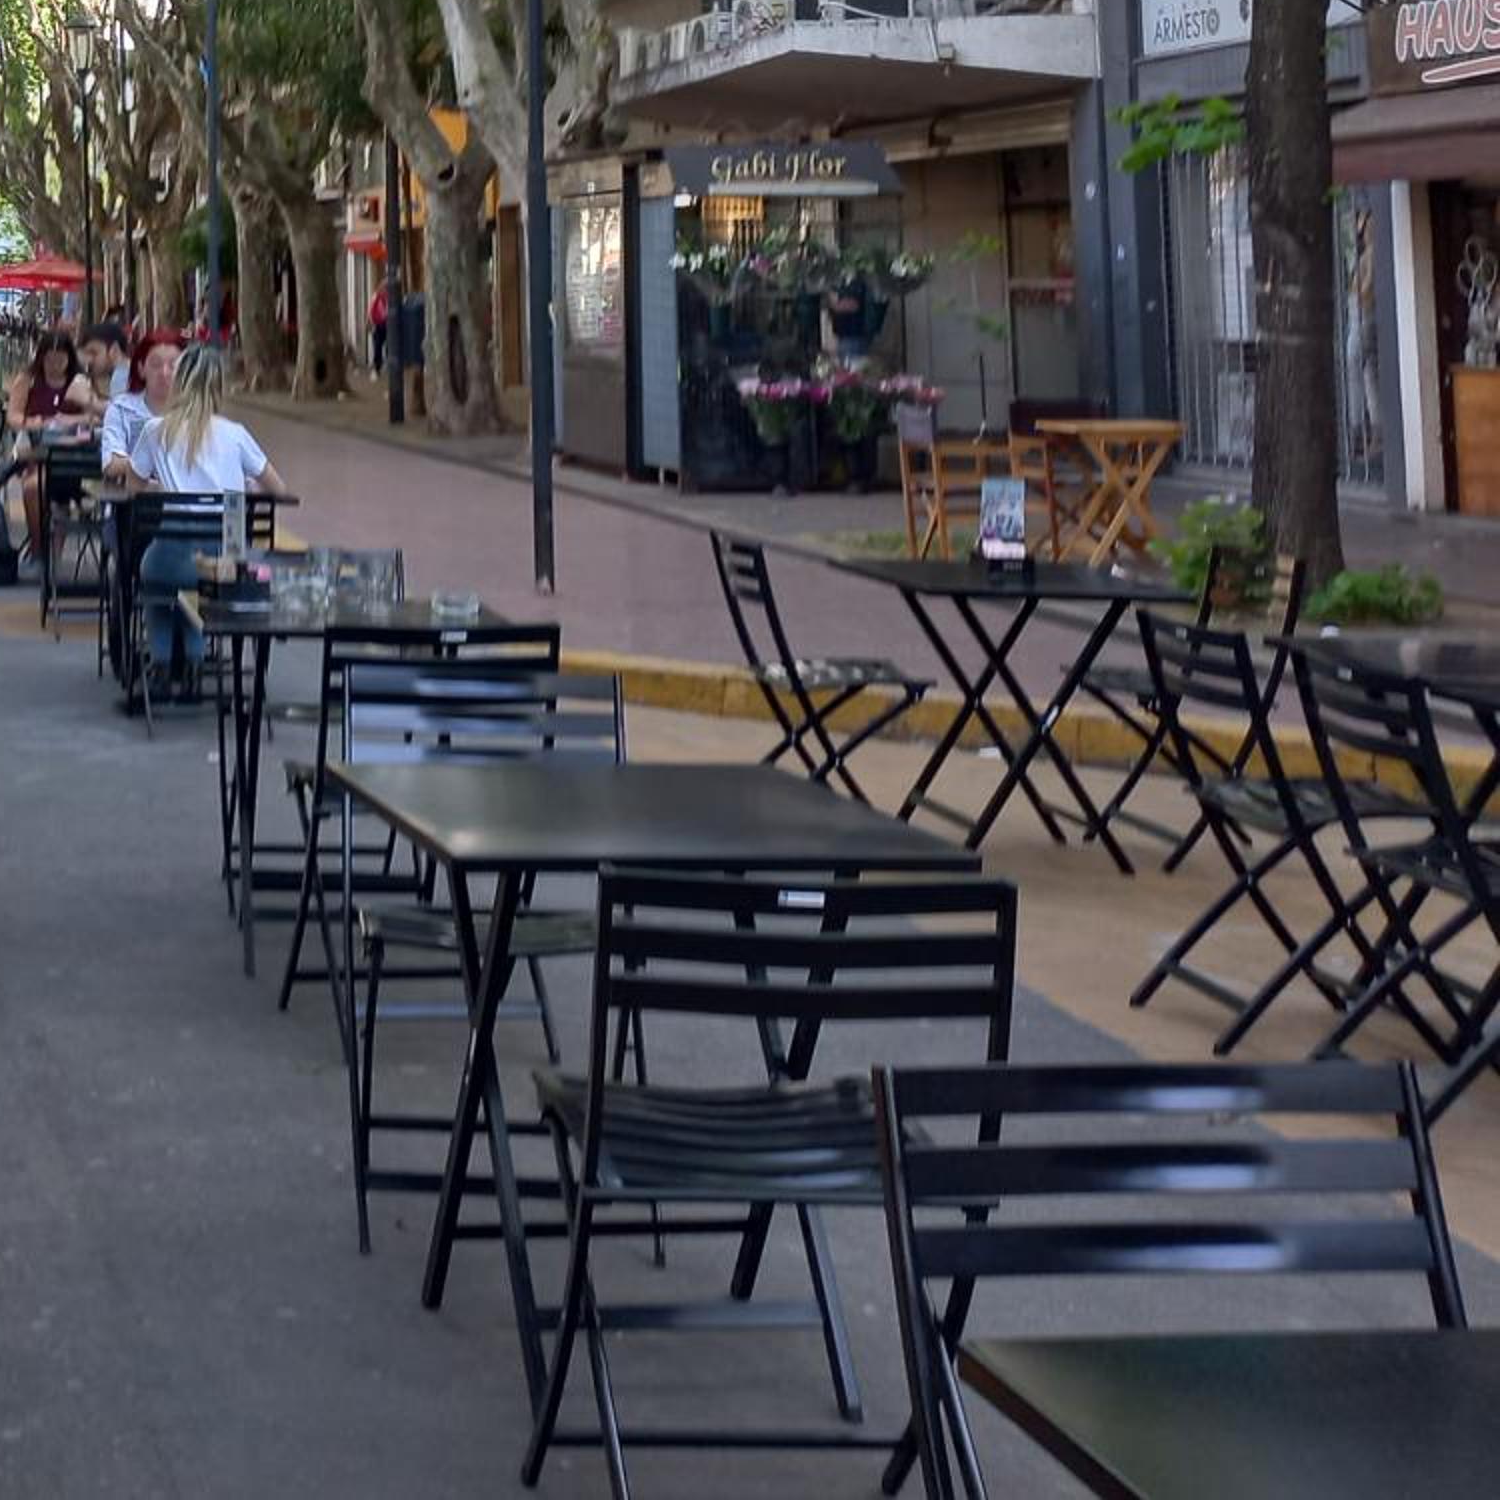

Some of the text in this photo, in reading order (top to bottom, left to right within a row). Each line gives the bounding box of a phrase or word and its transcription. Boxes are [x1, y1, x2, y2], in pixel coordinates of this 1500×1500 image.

[1153, 8, 1219, 45] ARMESTO
[711, 149, 847, 186] Gabi Flor
